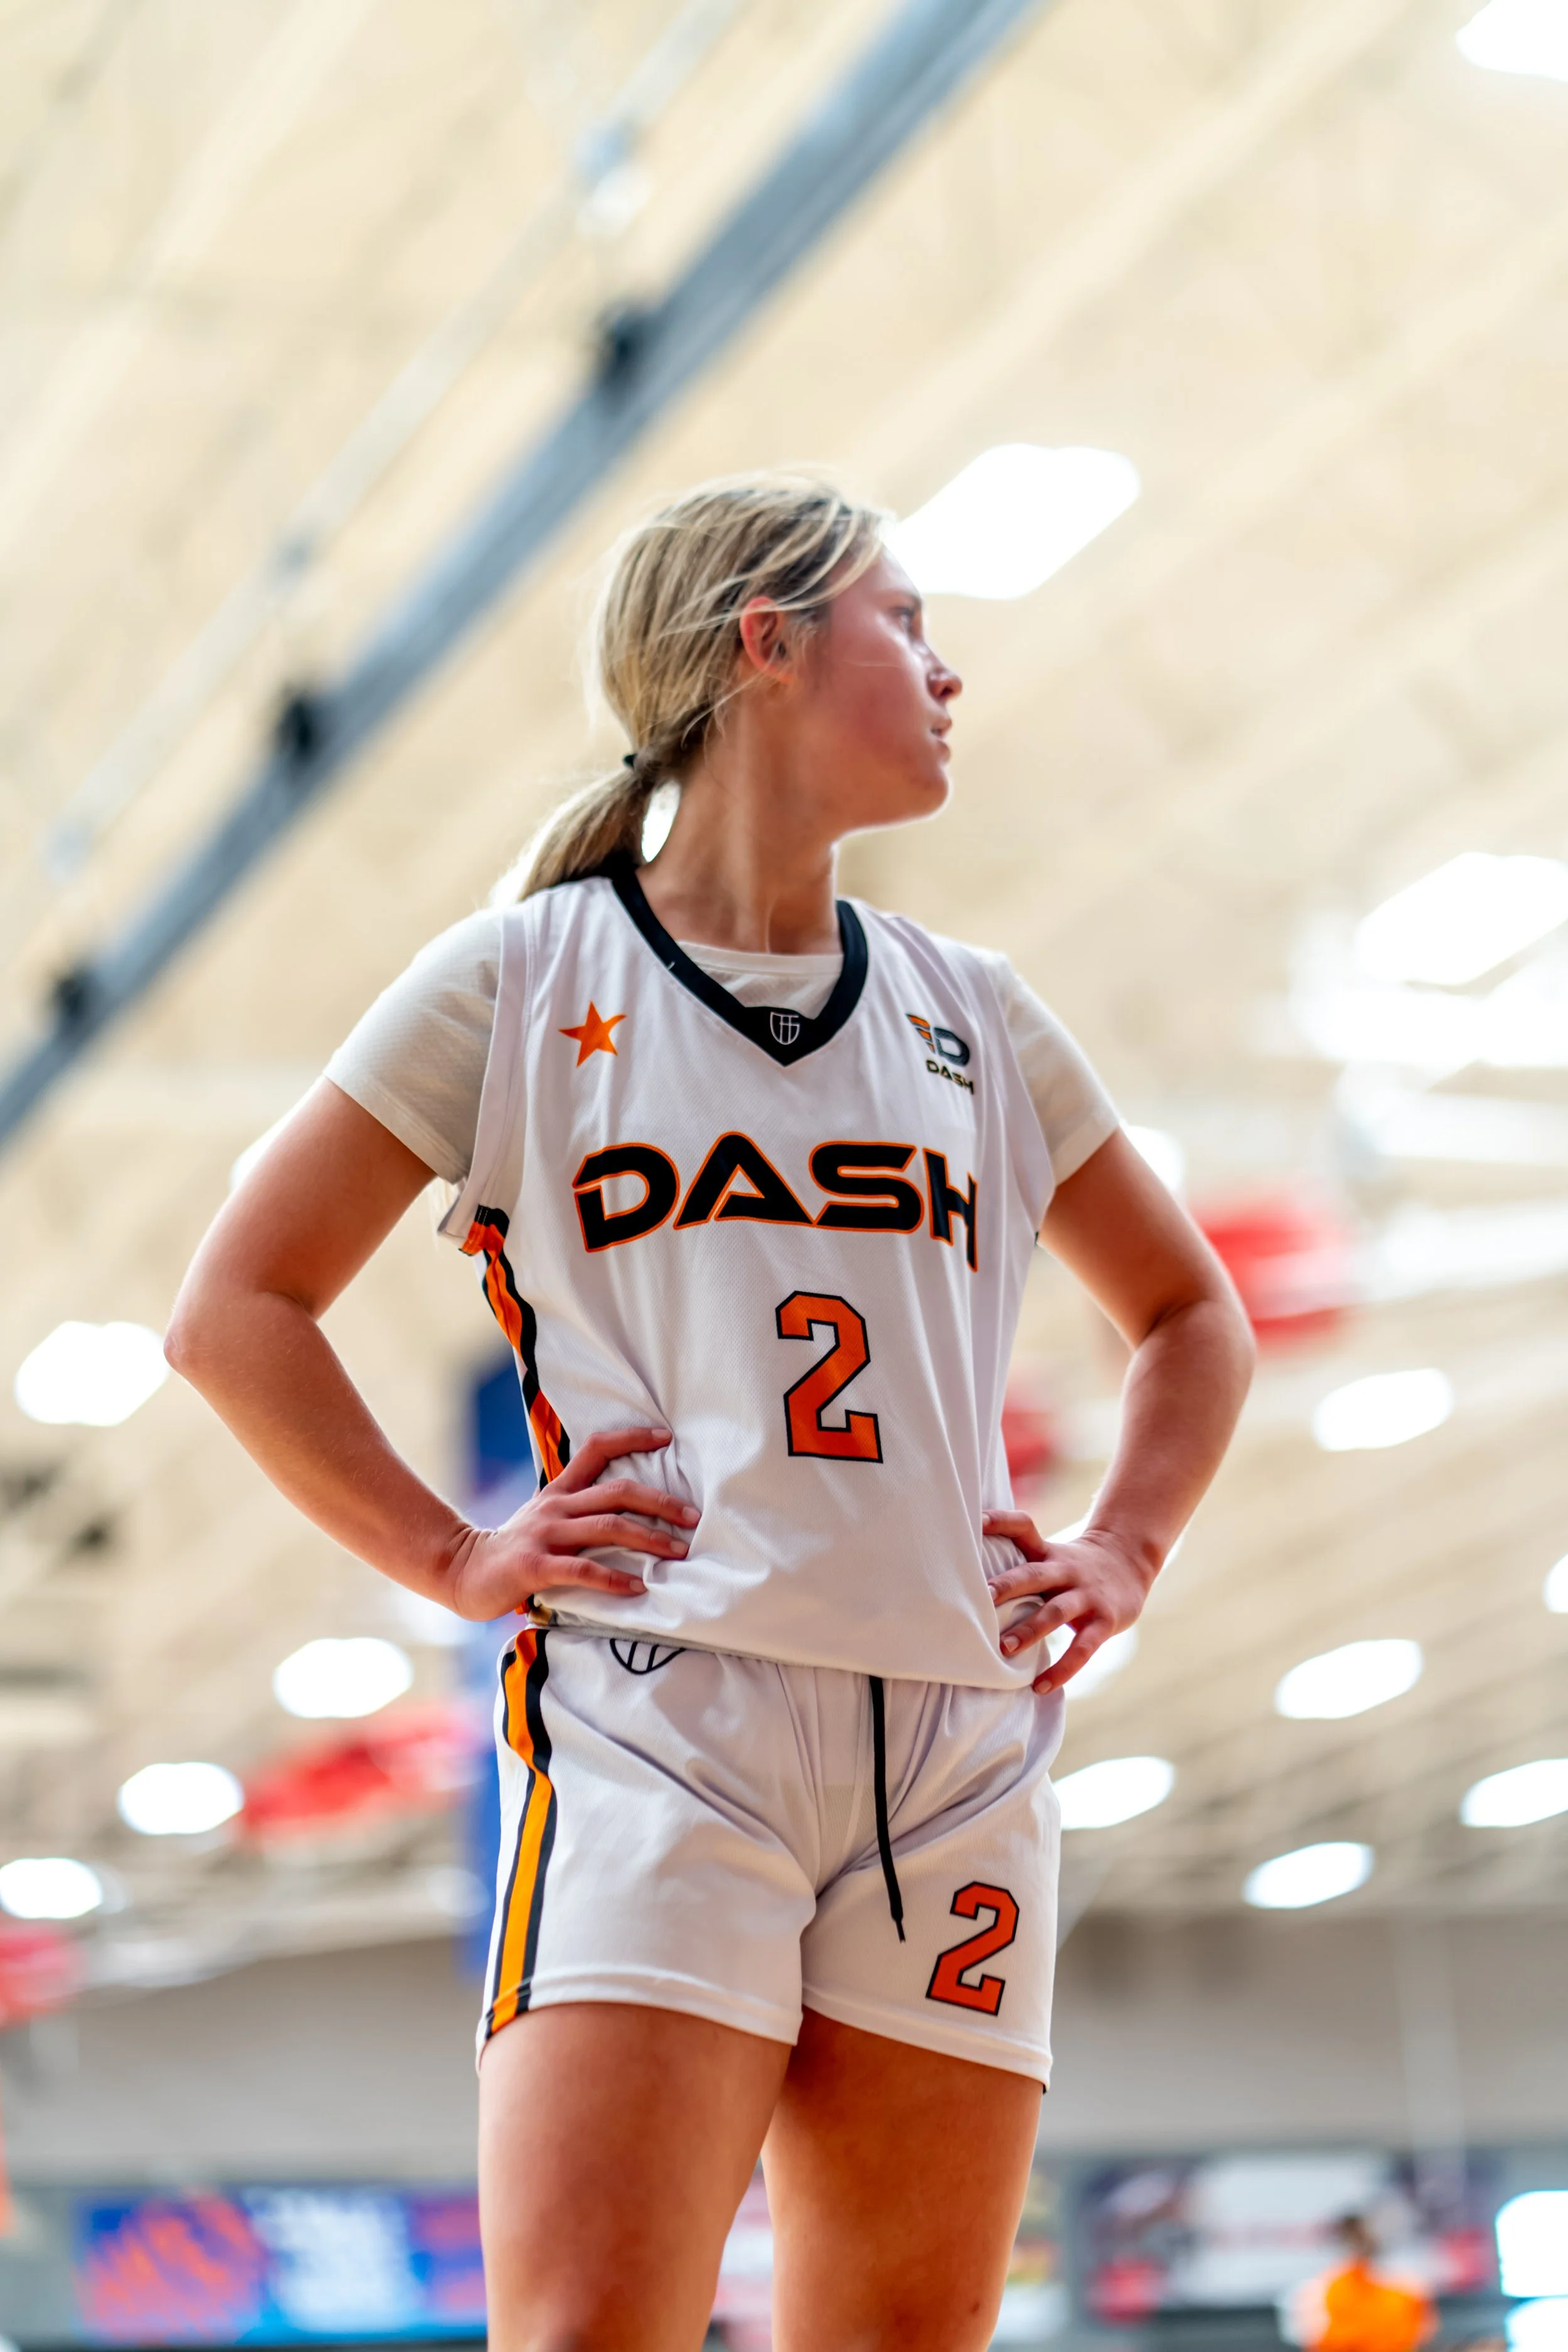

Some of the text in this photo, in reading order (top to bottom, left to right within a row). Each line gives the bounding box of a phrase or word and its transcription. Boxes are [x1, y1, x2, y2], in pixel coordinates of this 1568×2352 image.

[925, 1059, 975, 1095] DASH
[573, 1131, 978, 1272] DASH
[775, 1290, 883, 1463] 2
[925, 1882, 1020, 2016] 2
